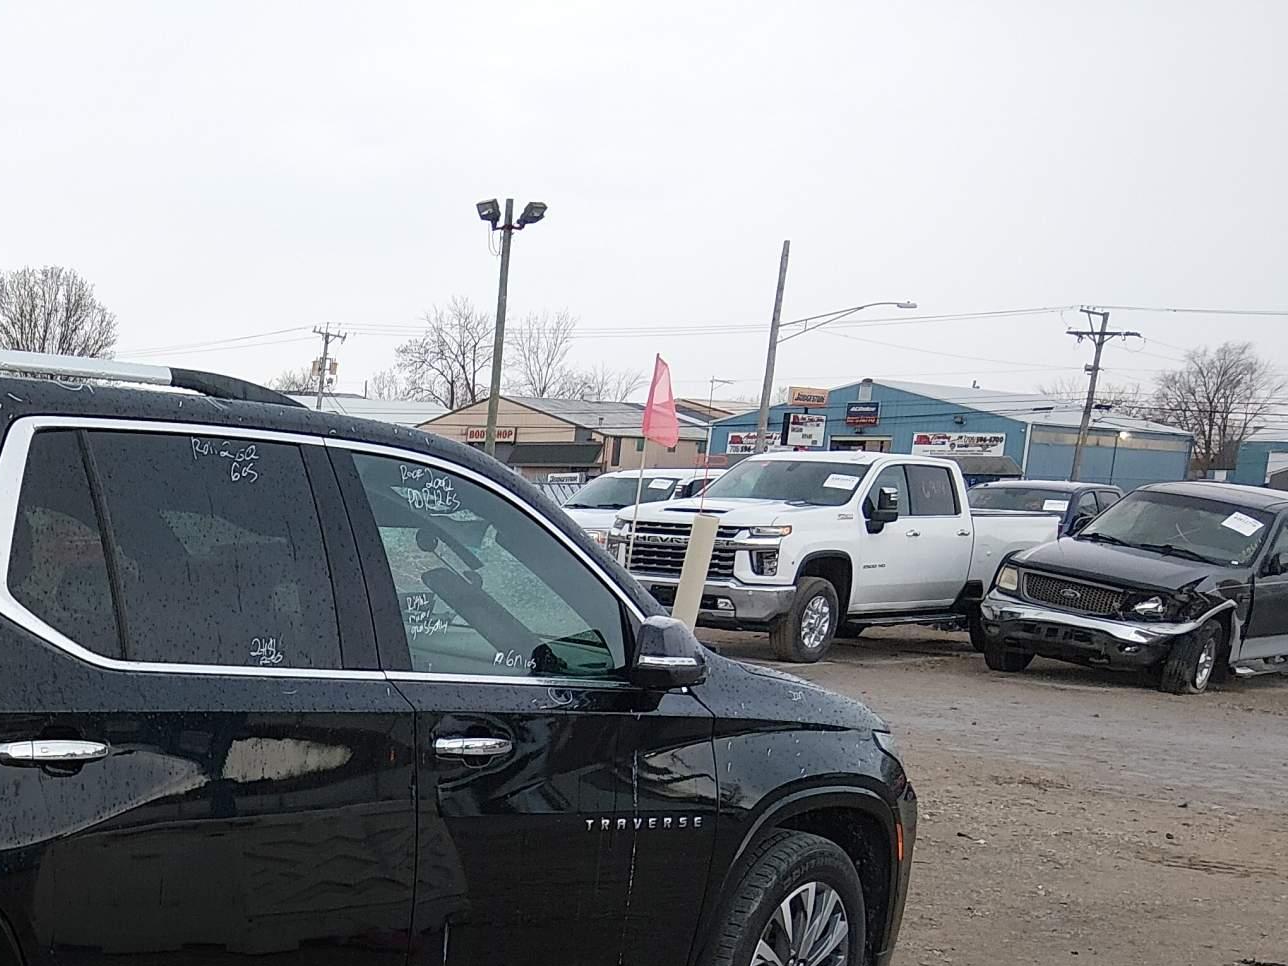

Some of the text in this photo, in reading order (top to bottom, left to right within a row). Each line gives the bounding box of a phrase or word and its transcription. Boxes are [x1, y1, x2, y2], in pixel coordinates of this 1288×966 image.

[469, 430, 513, 439] BOD HOP
[585, 816, 702, 831] TRAVERSE
